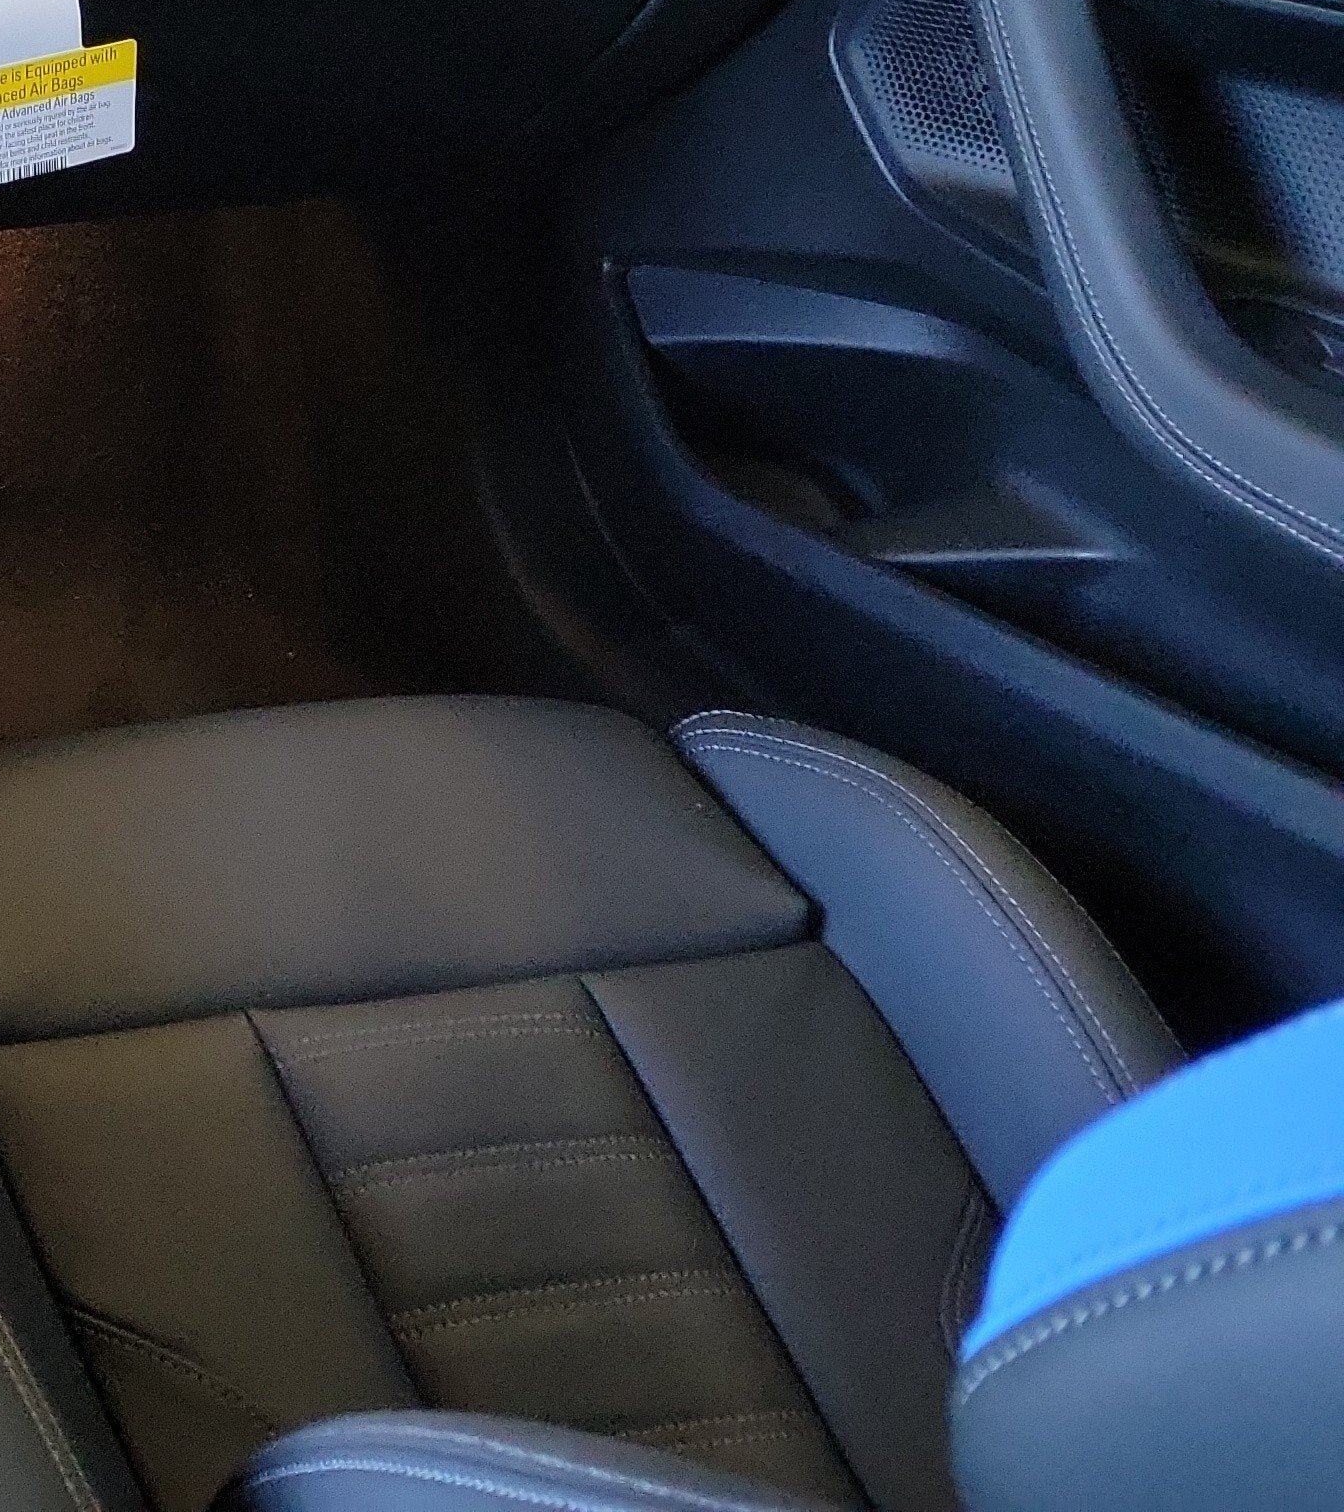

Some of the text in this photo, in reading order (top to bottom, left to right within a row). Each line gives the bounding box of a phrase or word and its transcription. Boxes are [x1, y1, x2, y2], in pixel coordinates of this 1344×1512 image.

[11, 68, 22, 83] is
[25, 52, 87, 80] Equipped
[90, 47, 118, 65] with
[29, 80, 49, 98] Air
[51, 75, 84, 92] Bags
[1, 98, 52, 120] Advanced
[53, 95, 68, 109] Air
[70, 91, 95, 105] Bags
